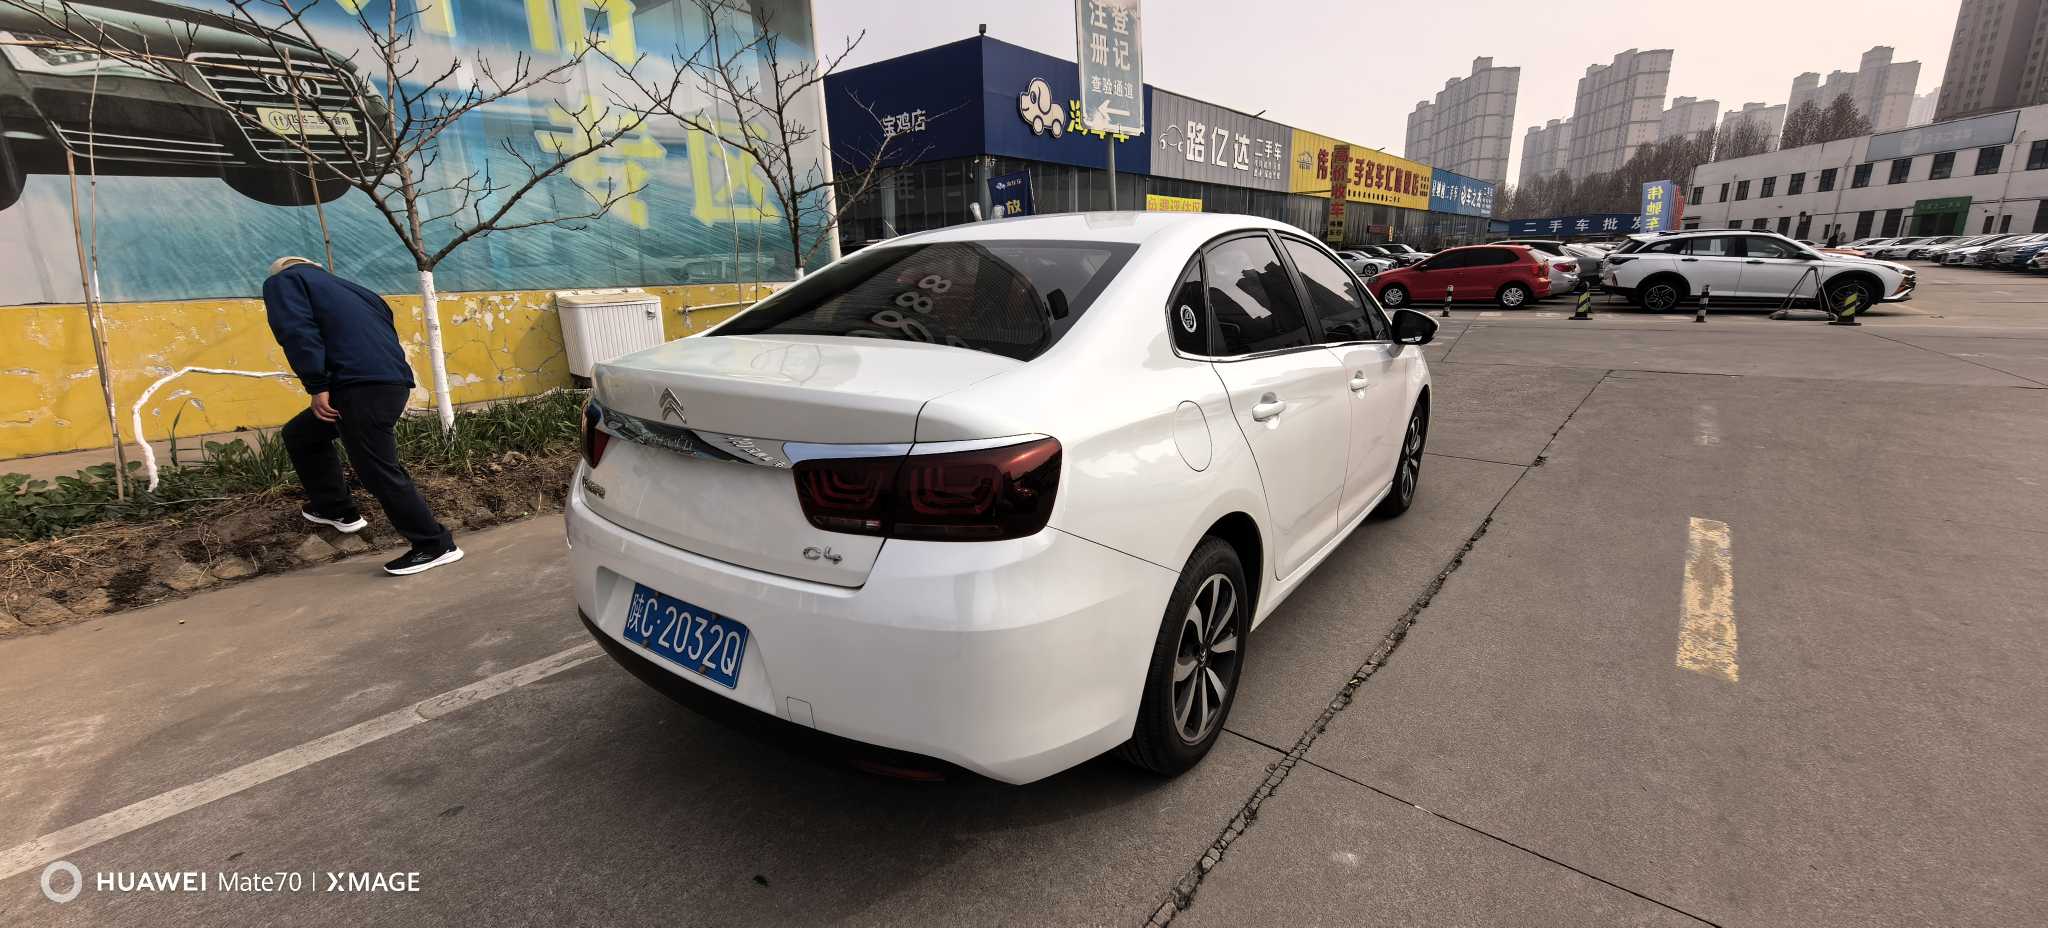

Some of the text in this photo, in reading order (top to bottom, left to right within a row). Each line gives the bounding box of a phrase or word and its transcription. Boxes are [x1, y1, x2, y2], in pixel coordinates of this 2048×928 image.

[1091, 76, 1134, 99] 查验通道
[881, 108, 927, 136] 宝鸡店
[1186, 120, 1250, 171] 路亿达
[1254, 138, 1283, 160] 二手车
[627, 591, 741, 677] 陕C·2032Q
